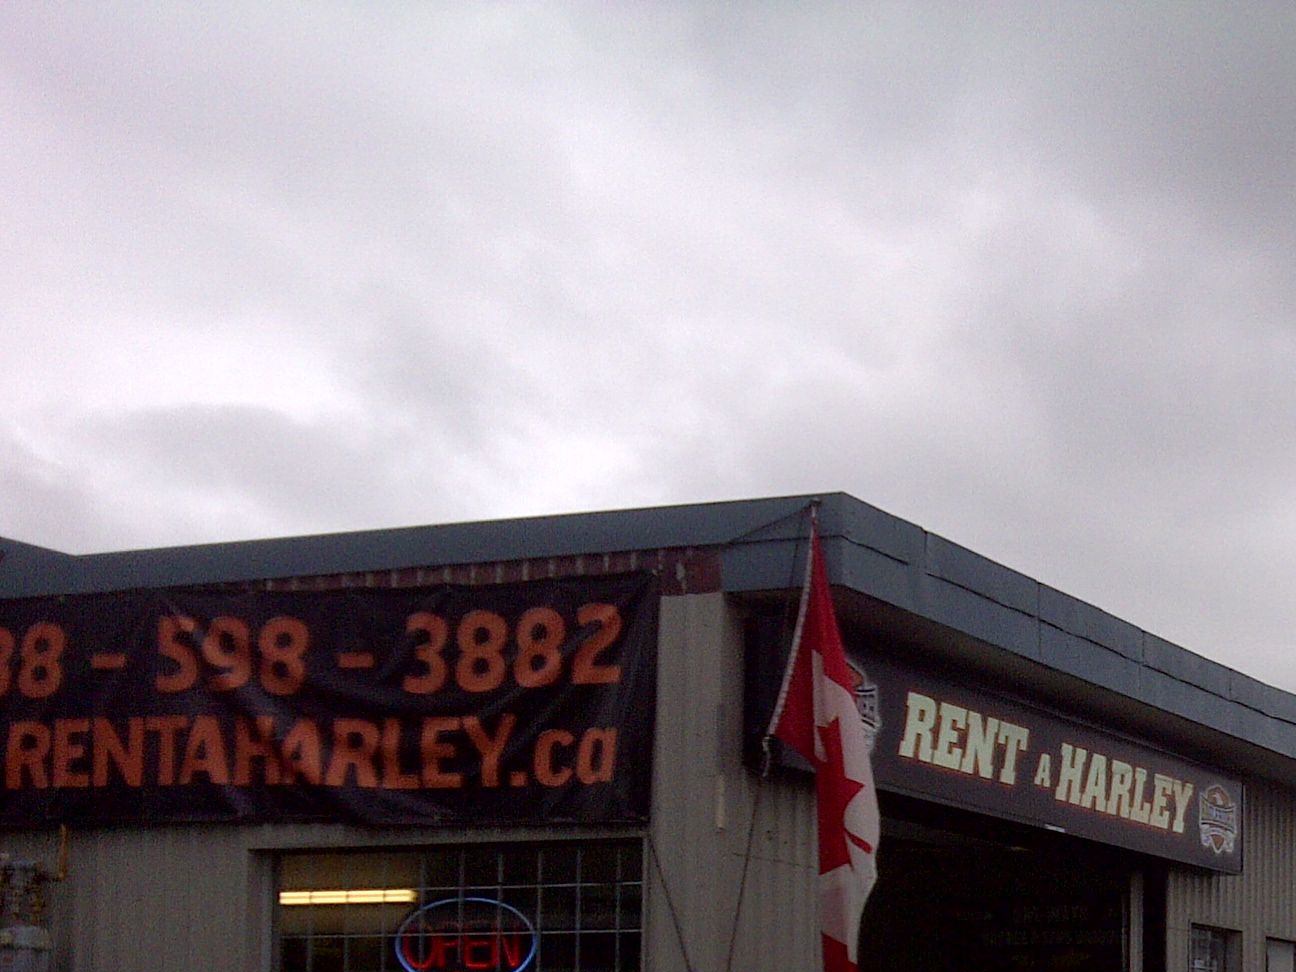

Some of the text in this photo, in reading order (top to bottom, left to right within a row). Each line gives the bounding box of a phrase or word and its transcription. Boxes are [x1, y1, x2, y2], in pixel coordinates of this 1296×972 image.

[153, 613, 312, 698] 598
[401, 601, 623, 694] 3882
[4, 711, 619, 791] RENTAHARLEY.ca
[898, 691, 1194, 834] RENT A HARLEY
[402, 926, 524, 971] OPEN
